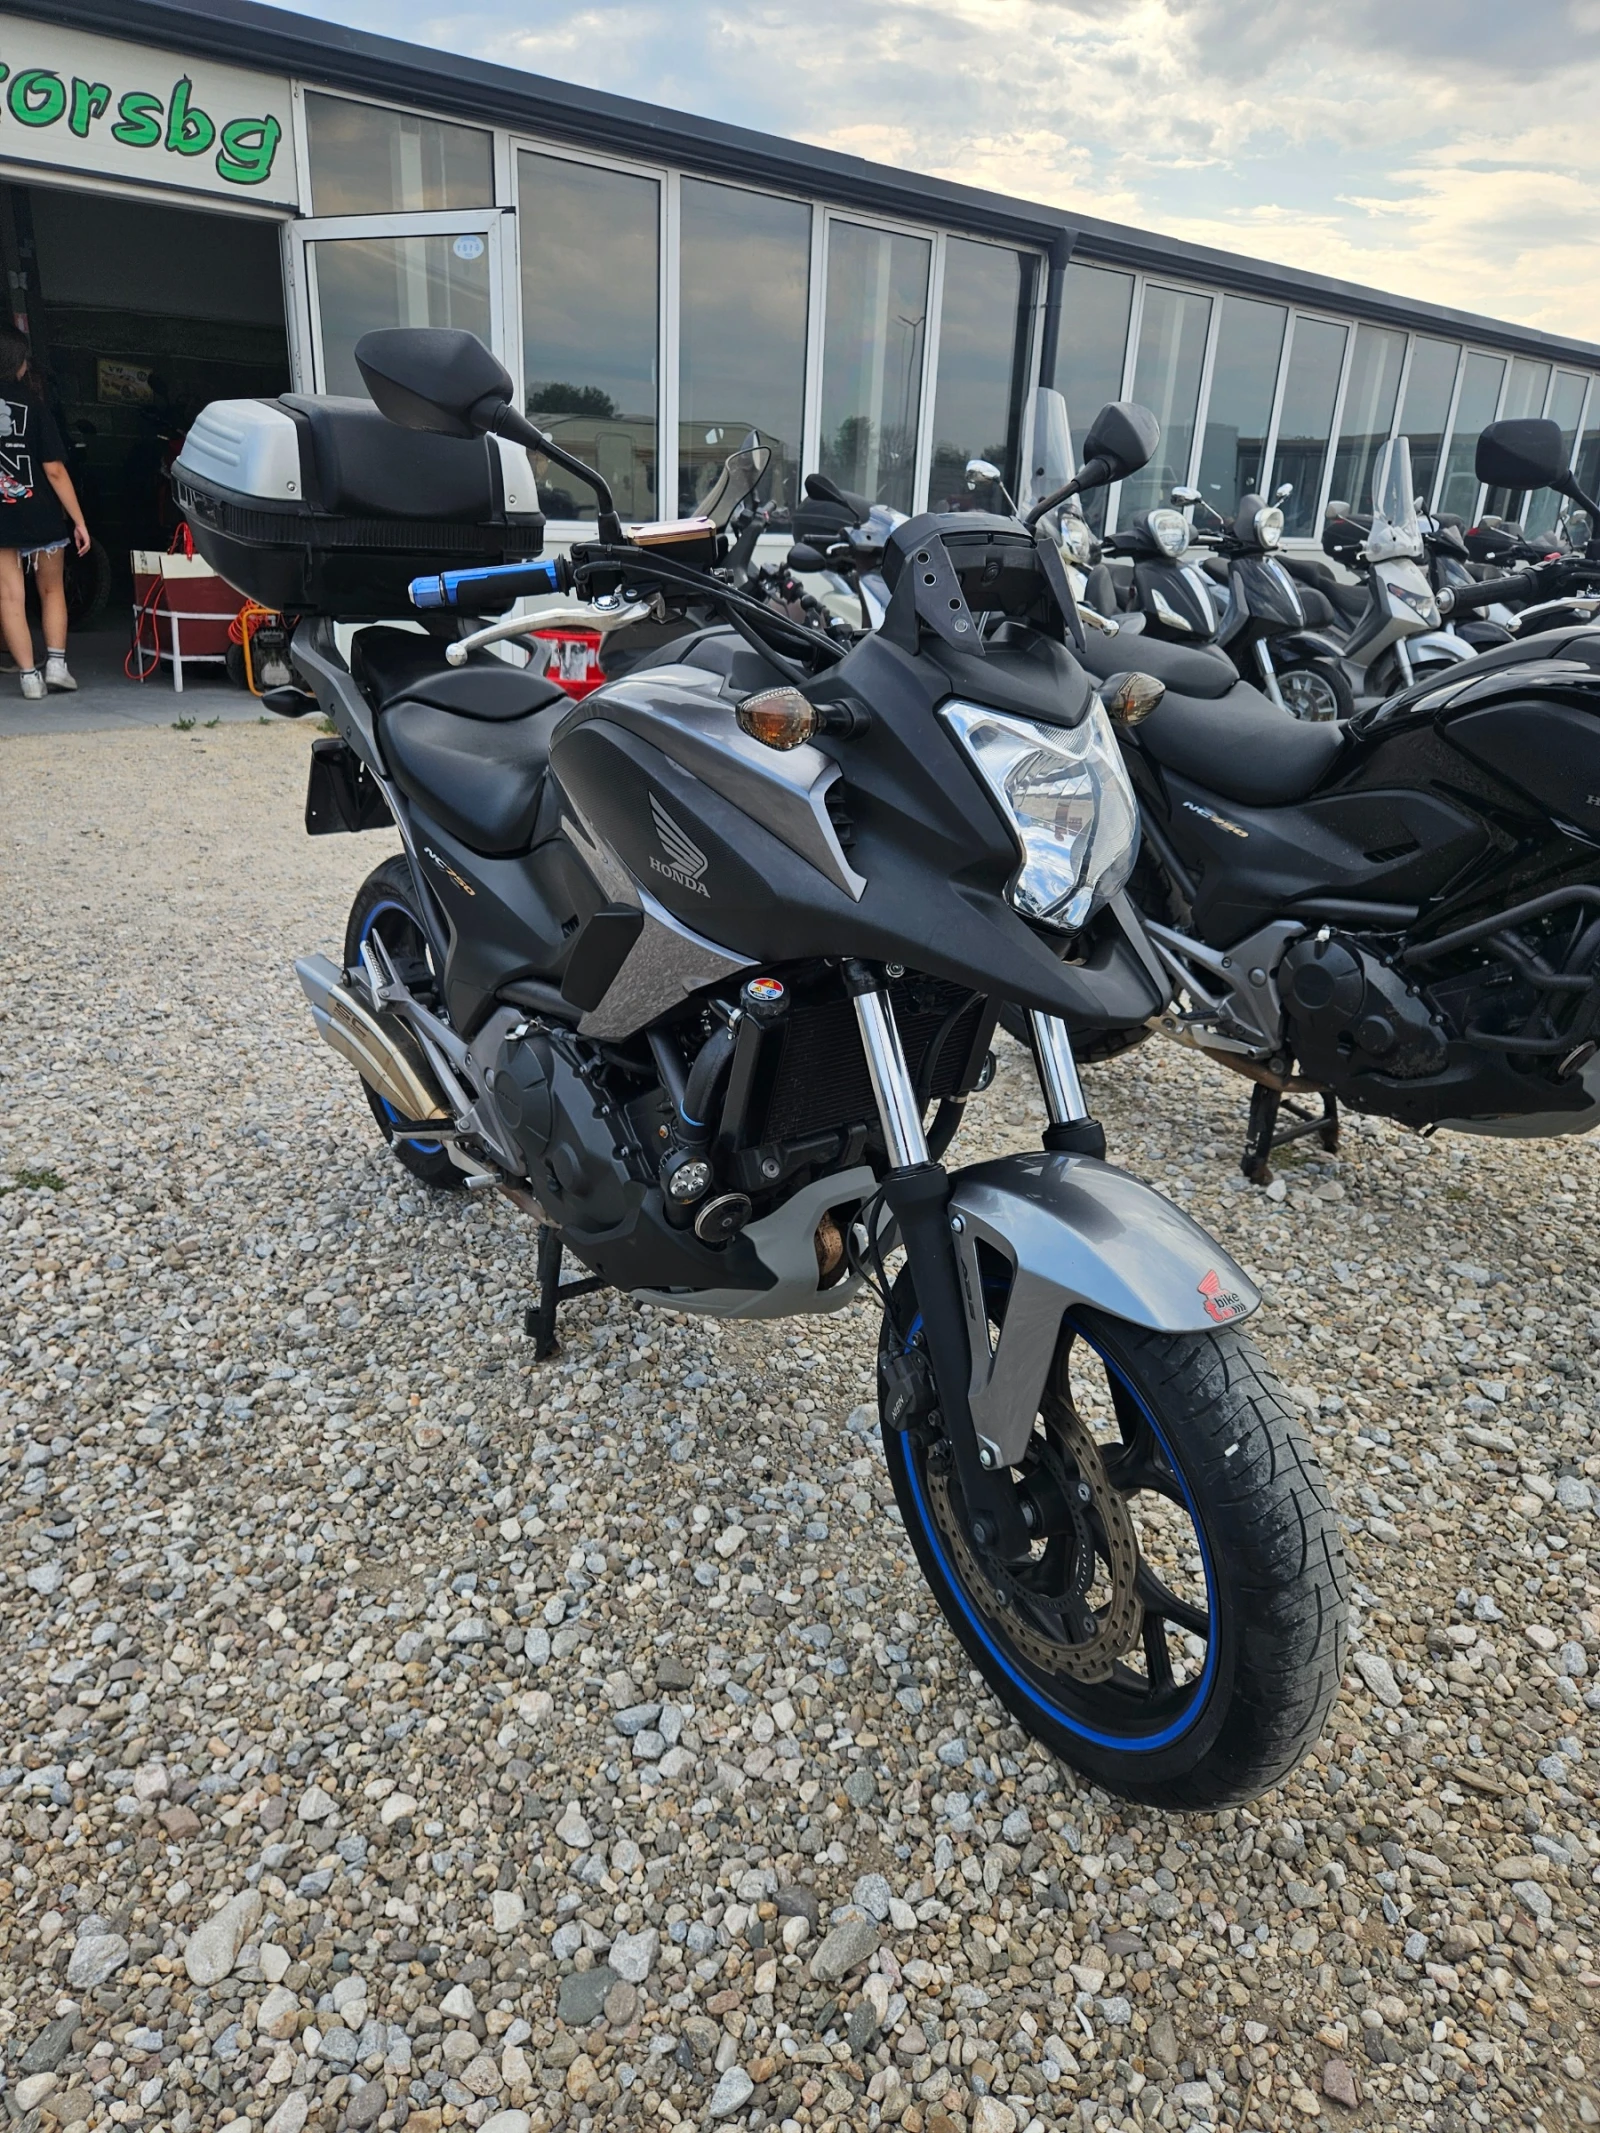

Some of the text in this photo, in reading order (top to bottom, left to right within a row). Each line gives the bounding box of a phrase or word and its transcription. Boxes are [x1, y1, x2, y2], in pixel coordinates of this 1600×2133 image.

[0, 62, 282, 185] orsbg
[649, 855, 711, 899] HONDA
[1213, 1293, 1240, 1309] bike
